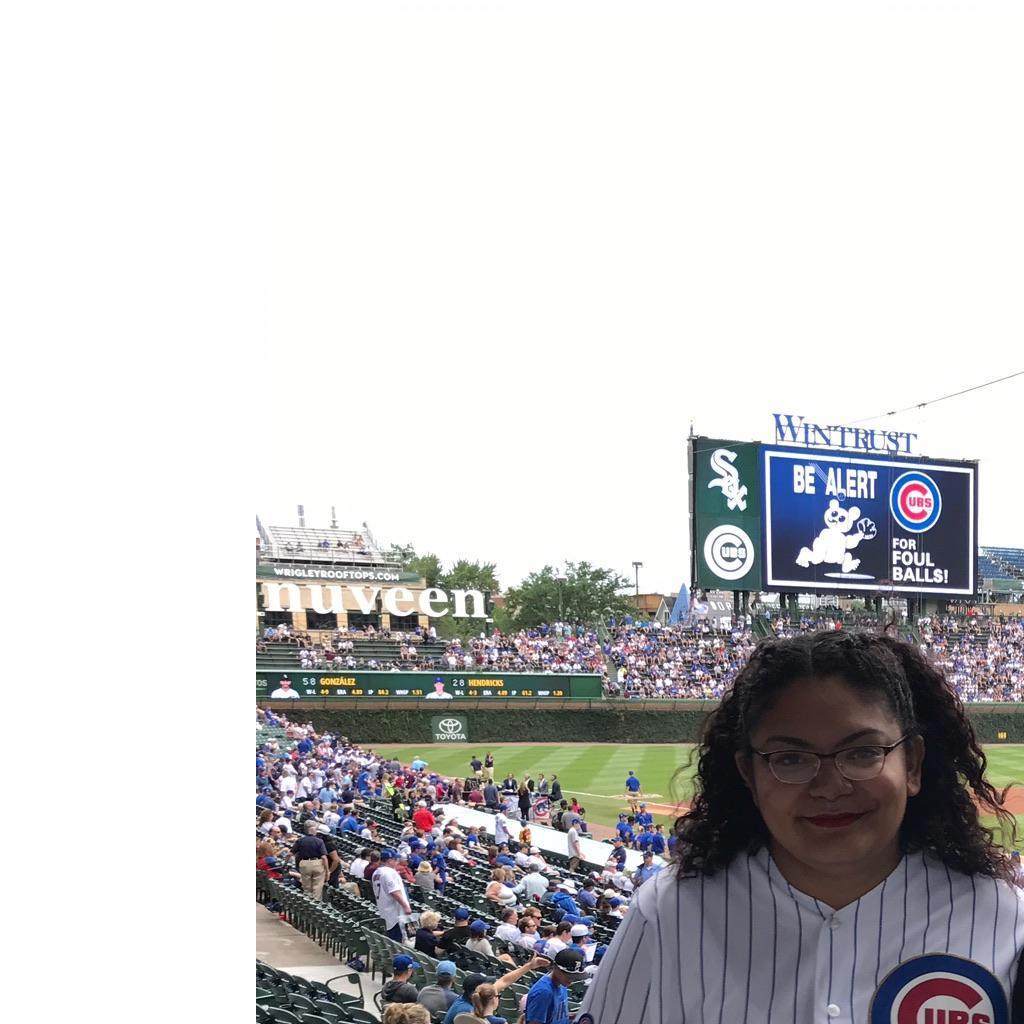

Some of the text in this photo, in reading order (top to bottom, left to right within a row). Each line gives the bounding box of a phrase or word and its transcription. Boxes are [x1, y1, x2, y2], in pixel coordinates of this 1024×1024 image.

[772, 413, 917, 453] WINTRUST
[793, 464, 878, 499] BE ALERT
[892, 538, 916, 550] FOR
[892, 551, 935, 567] FOUL
[274, 567, 400, 581] WRIGLEYROOFTOPS.COM
[892, 566, 949, 584] BALLS!
[260, 583, 488, 618] nuveen
[256, 679, 267, 687] OS
[468, 679, 504, 687] HENDRICKS
